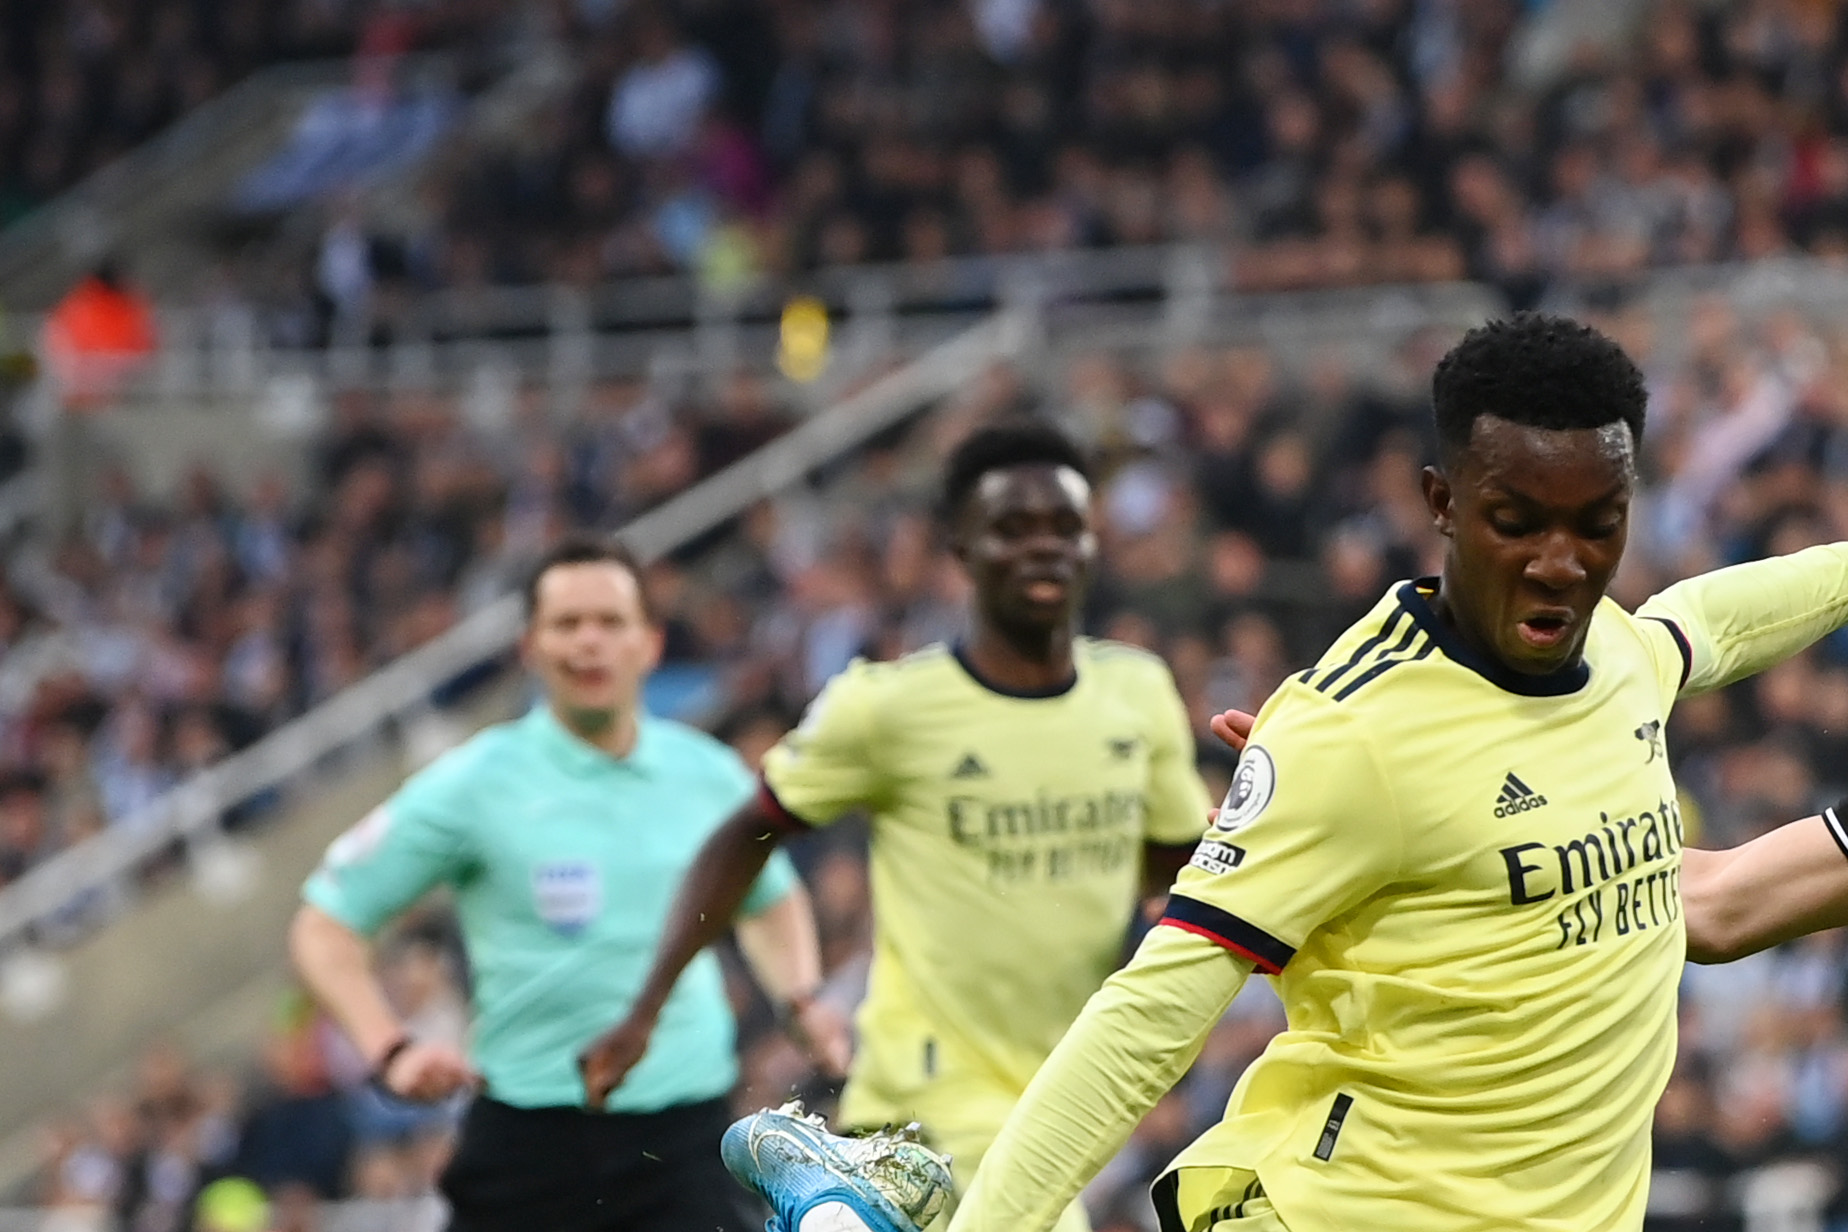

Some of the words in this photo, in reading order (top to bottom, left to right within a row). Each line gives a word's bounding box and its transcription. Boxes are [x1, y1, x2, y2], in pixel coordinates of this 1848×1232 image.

[1493, 794, 1548, 819] adidas
[1557, 890, 1603, 950] FLY
[1615, 865, 1681, 936] BETTE
